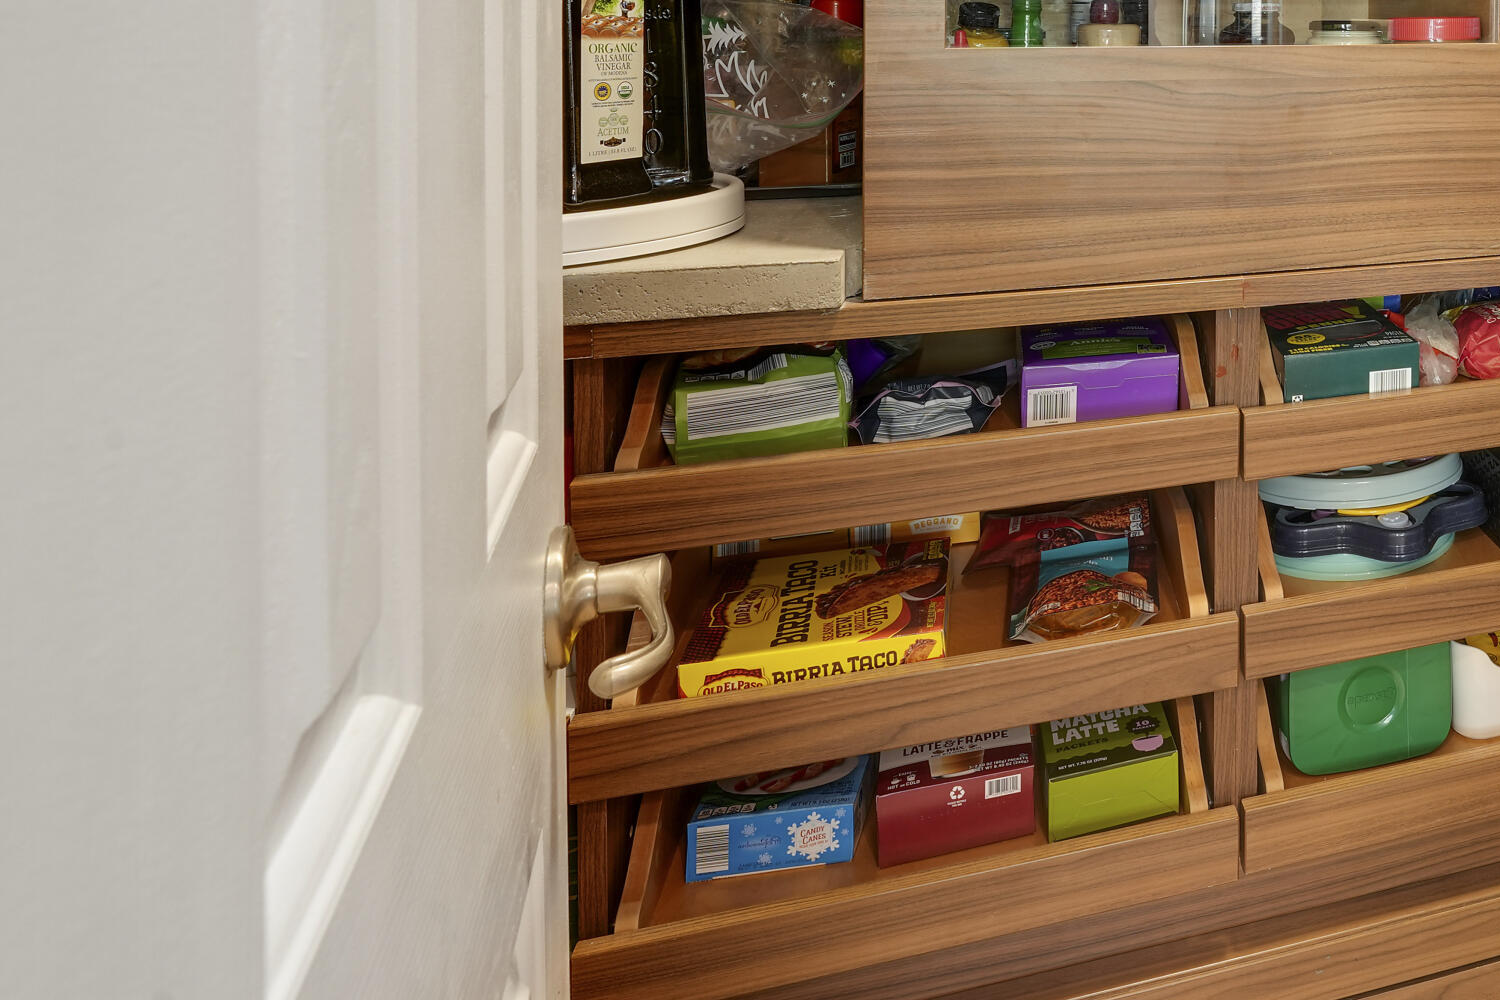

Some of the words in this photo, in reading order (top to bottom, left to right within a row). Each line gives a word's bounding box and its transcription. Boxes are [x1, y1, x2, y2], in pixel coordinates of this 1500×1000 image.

[588, 42, 638, 54] ORGANIC
[594, 53, 633, 63] BALSAMIC
[596, 62, 632, 71] VINEGAR
[597, 127, 629, 137] ACETUM
[780, 560, 819, 598] TACO
[770, 595, 814, 648] BIRRIA
[772, 661, 845, 686] BIRRIA
[847, 650, 898, 674] TACO
[1050, 704, 1149, 732] MATCHA
[1135, 719, 1150, 727] 10
[1052, 719, 1120, 746] LATTE
[903, 740, 941, 757] LATTE
[944, 738, 957, 748] &
[957, 730, 1009, 747] FRAPPE
[1056, 737, 1109, 753] PACKETS
[887, 783, 899, 791] HOT
[905, 779, 921, 787] COLD
[800, 825, 826, 838] CANDY
[802, 833, 827, 846] CANES
